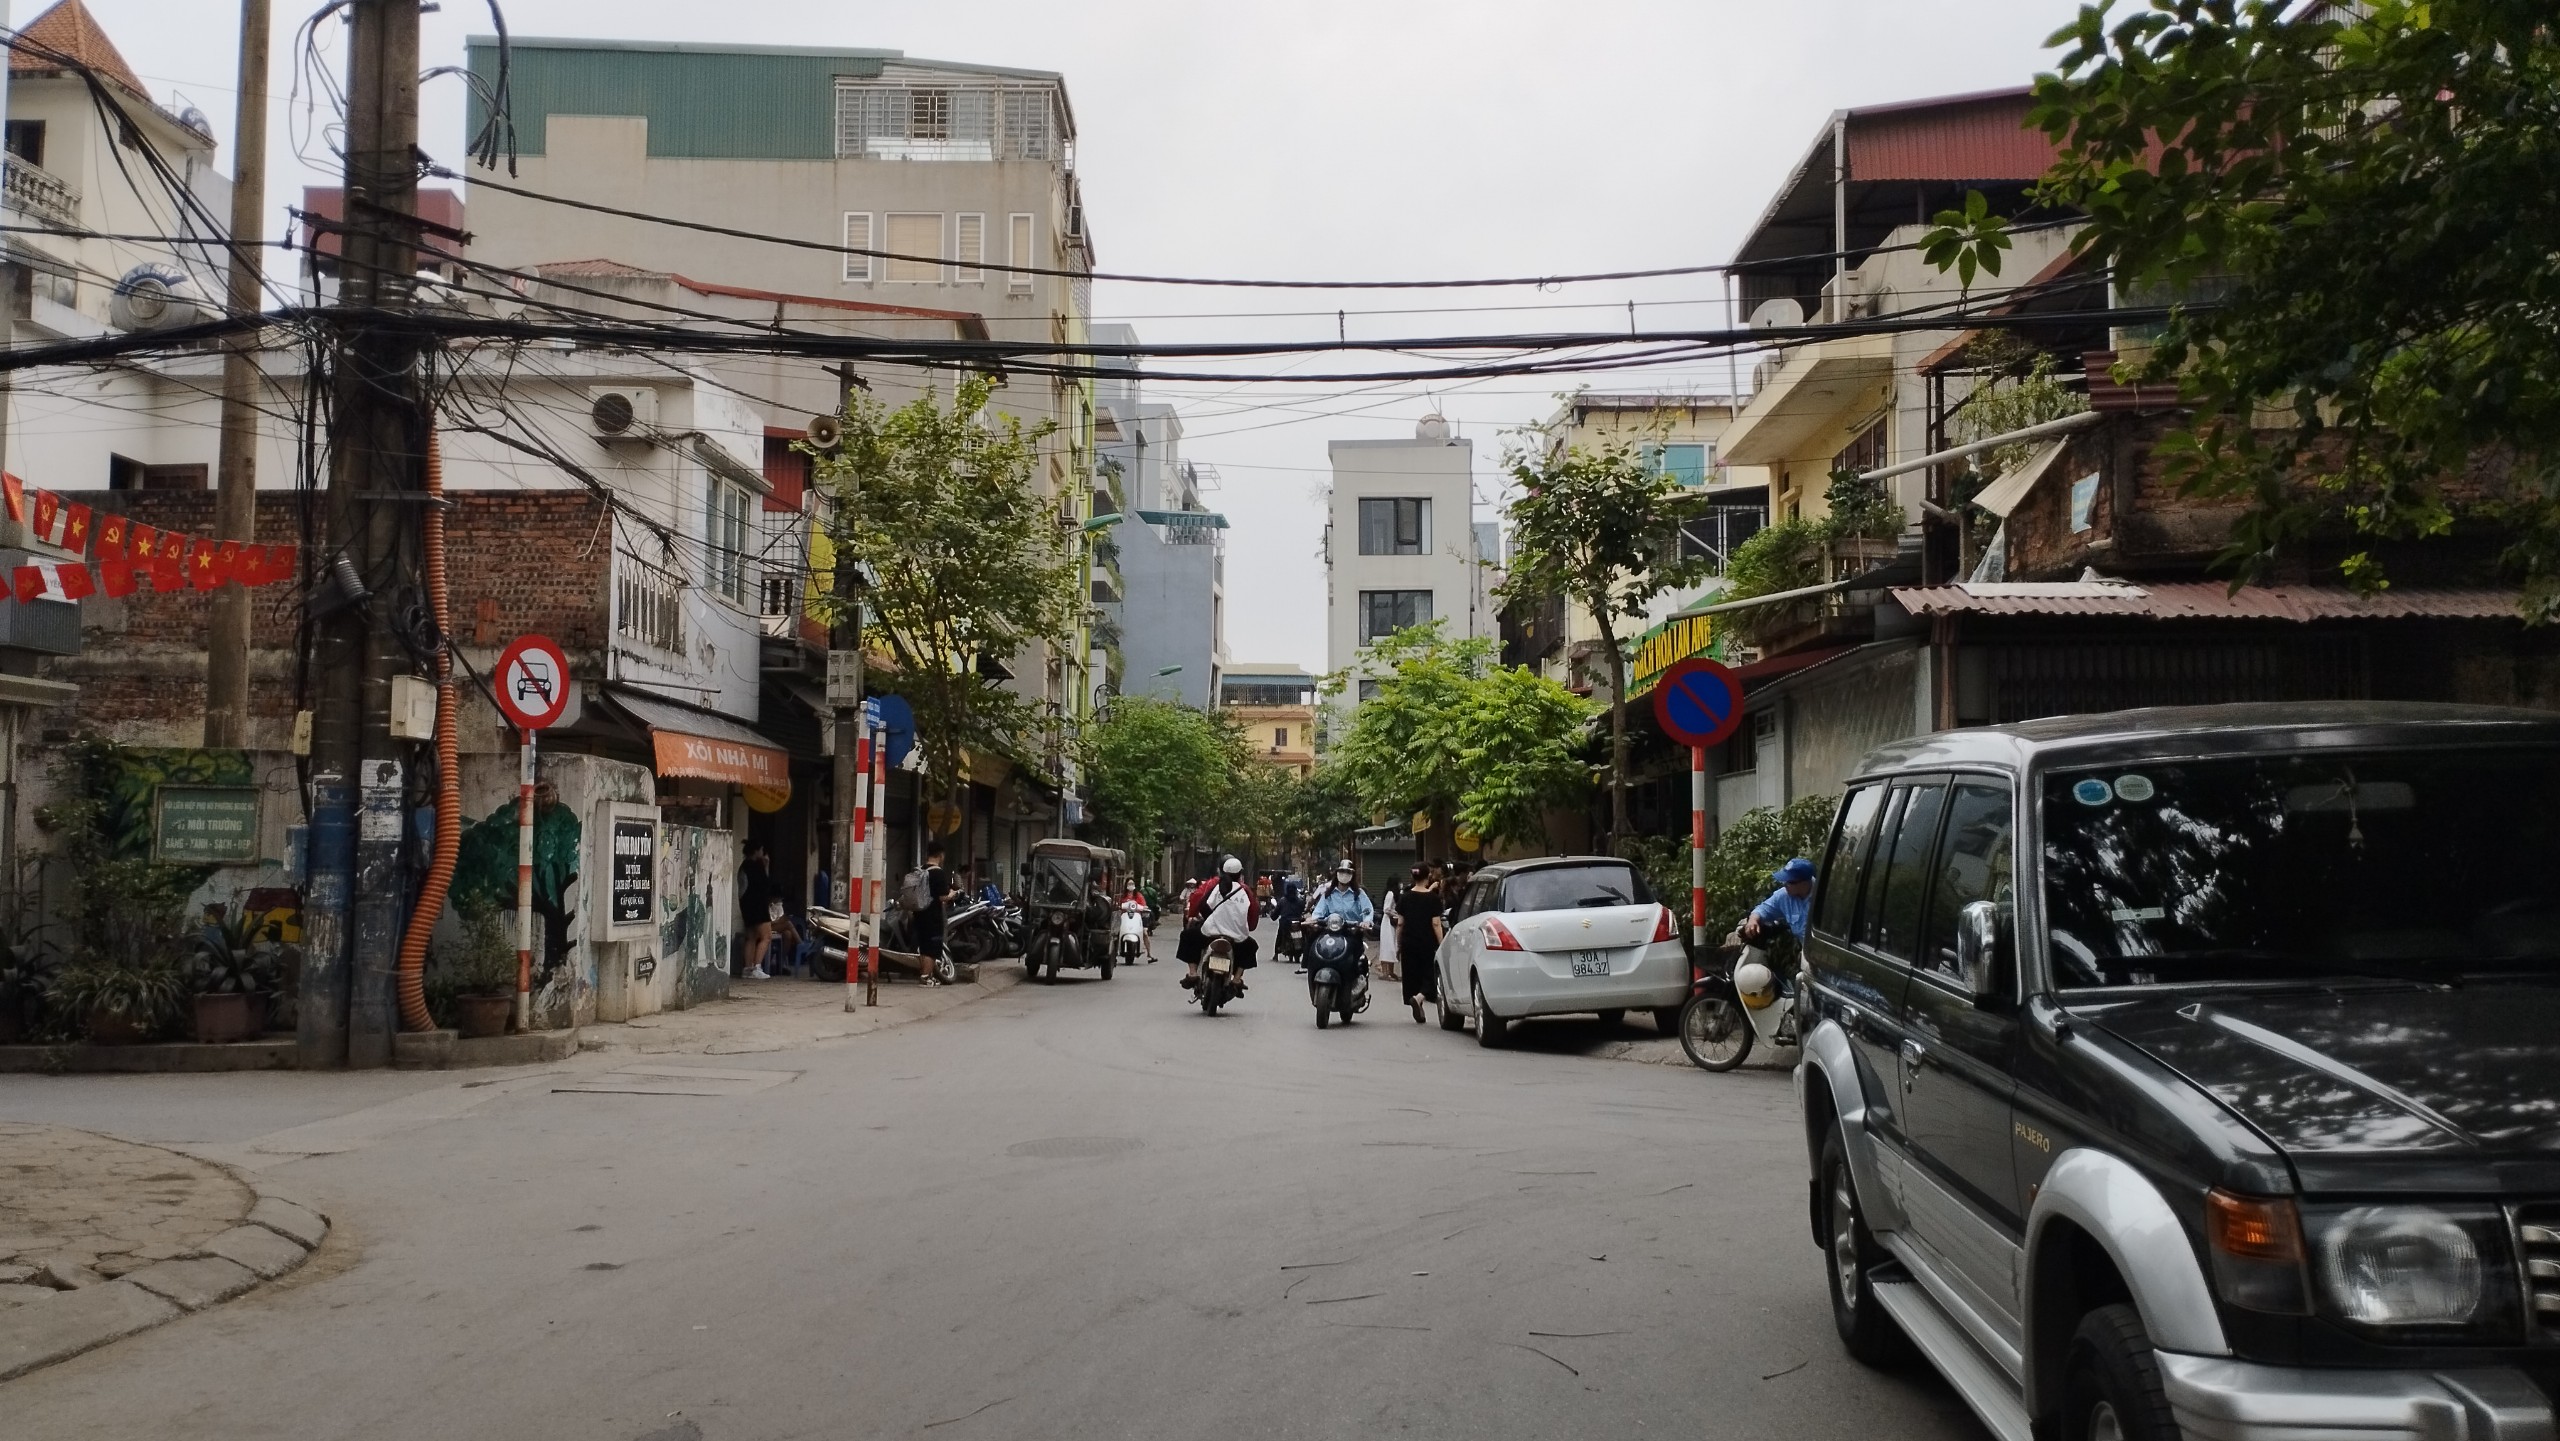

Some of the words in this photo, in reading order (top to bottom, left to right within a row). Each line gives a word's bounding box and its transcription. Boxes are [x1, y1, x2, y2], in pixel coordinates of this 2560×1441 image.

[1674, 618, 1690, 663] LAN
[684, 740, 713, 762] XÔI
[716, 747, 749, 768] NHÀ
[752, 753, 769, 776] MỊ
[187, 817, 205, 831] MÔI
[207, 817, 243, 831] TRƯỜNG
[165, 836, 184, 849] SÁNG
[1580, 951, 1599, 962] 30A
[1573, 962, 1607, 975] 984.37
[2014, 1121, 2050, 1153] PAJERO
